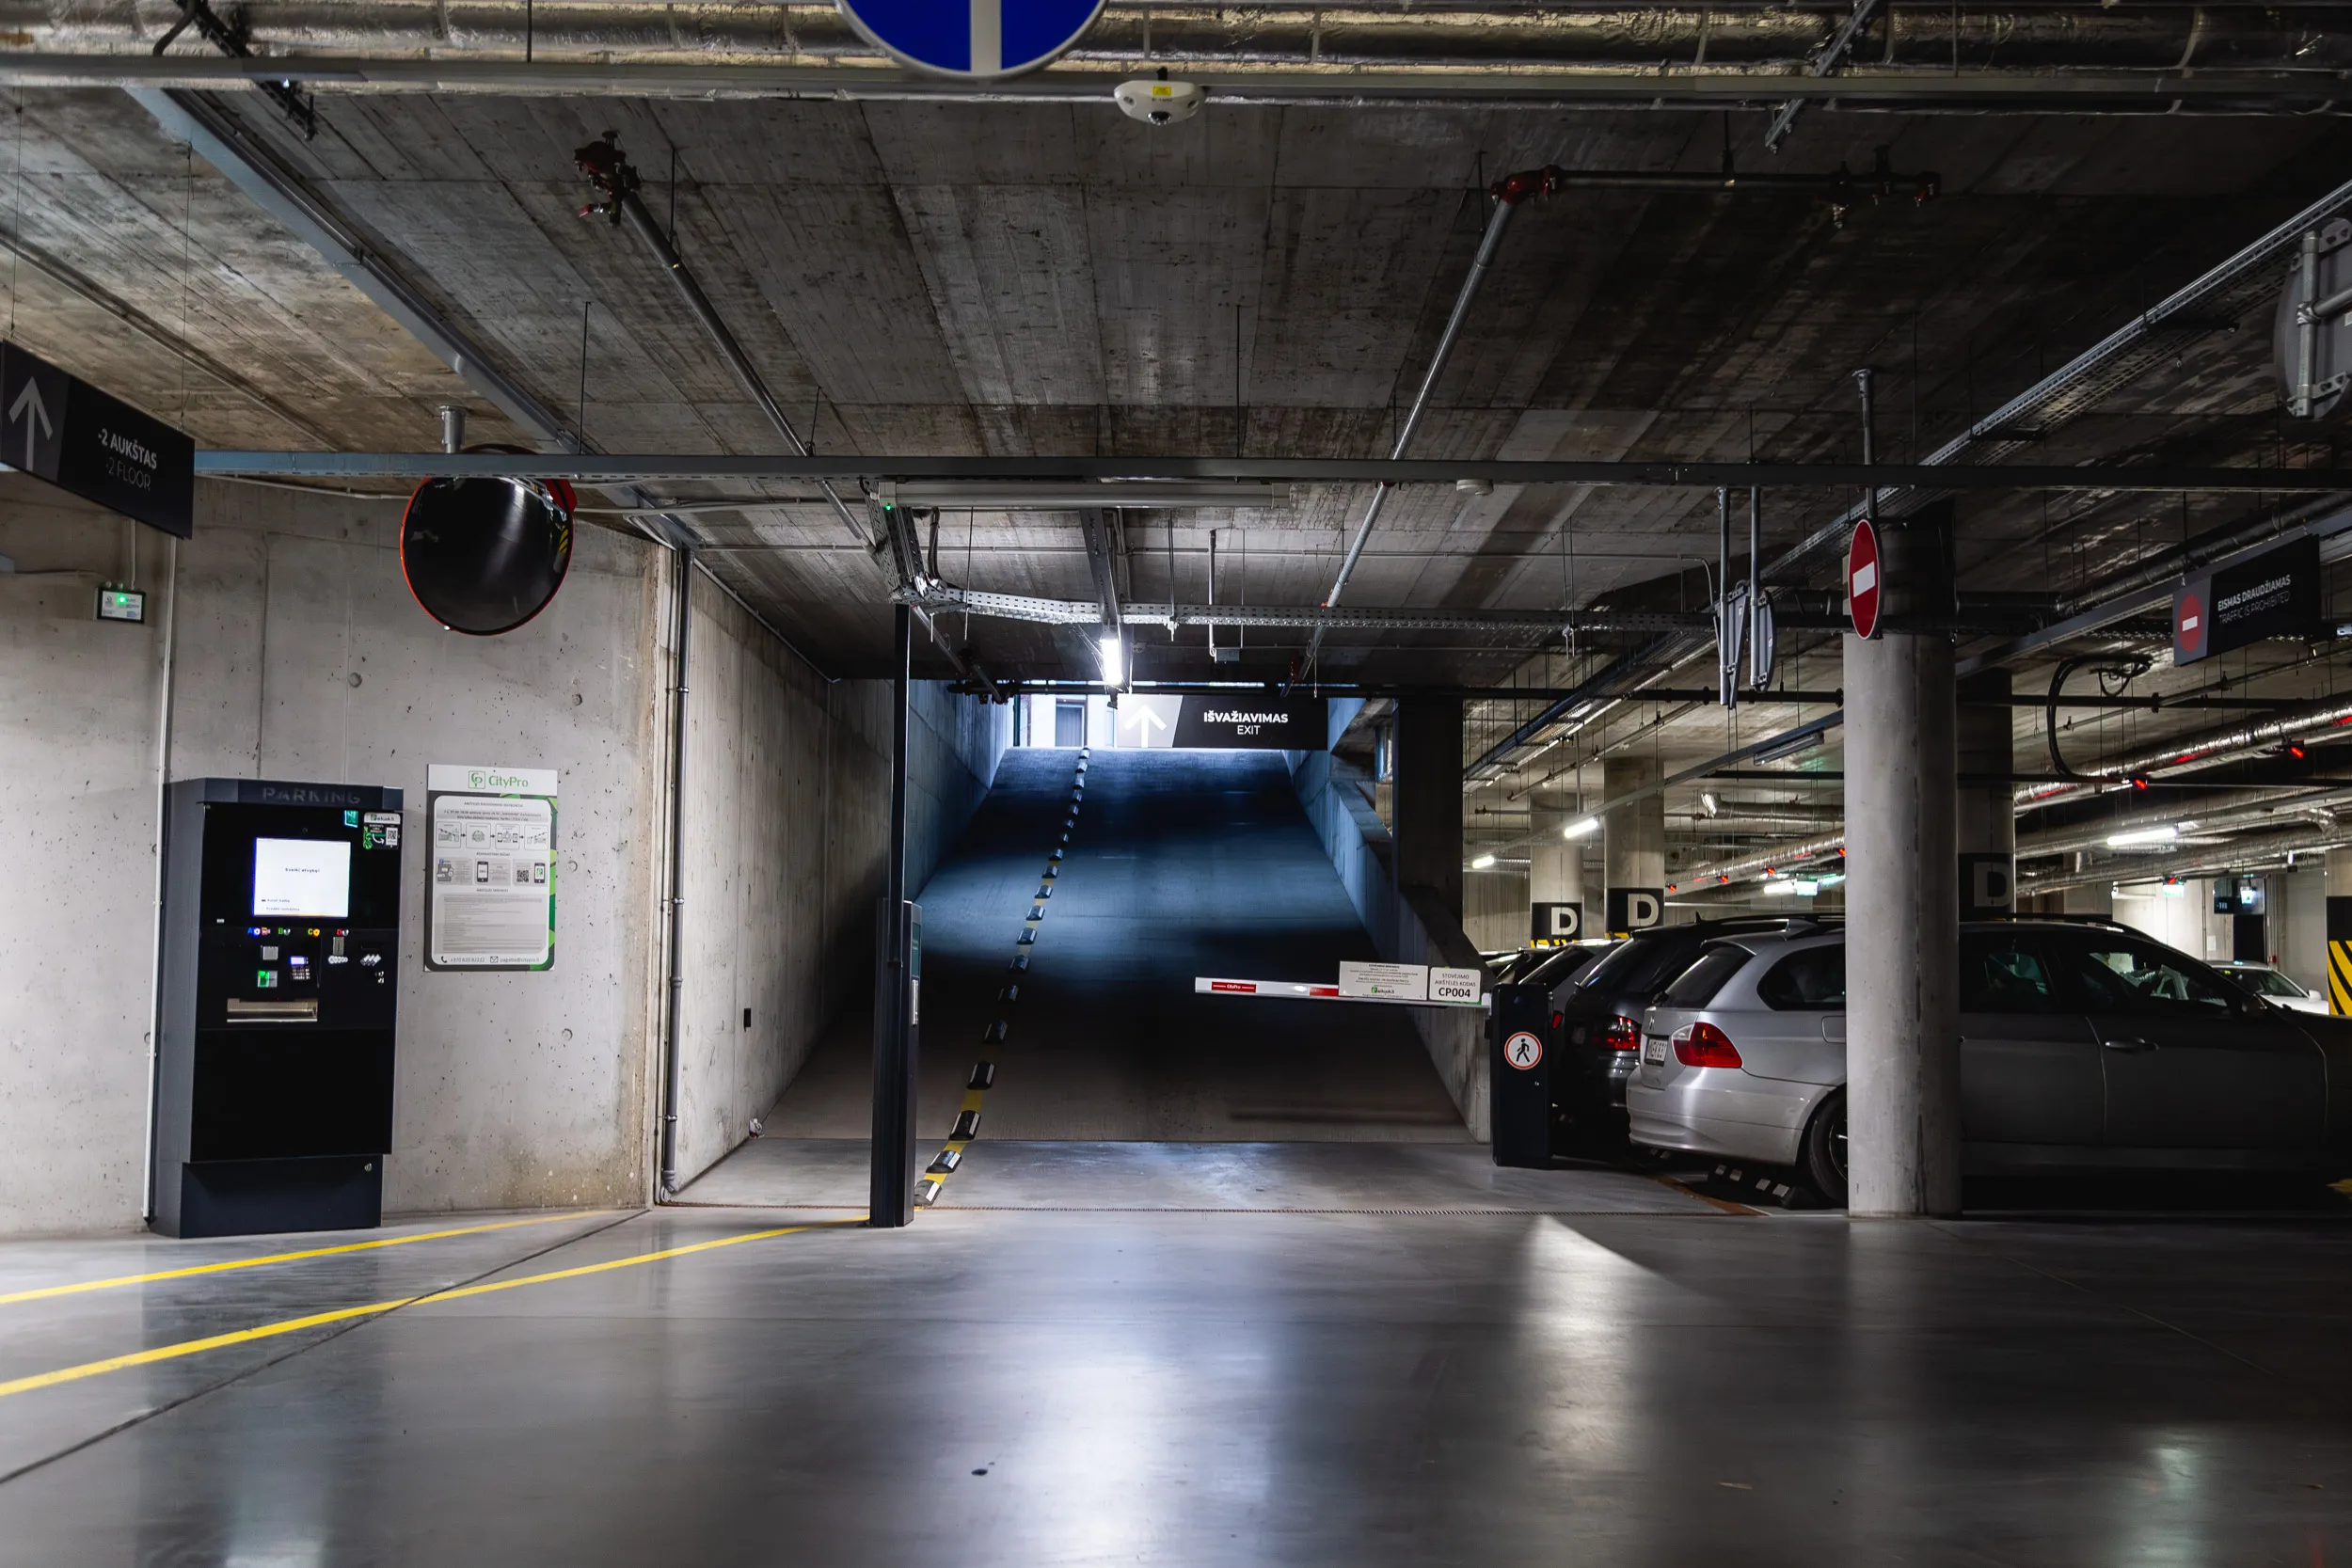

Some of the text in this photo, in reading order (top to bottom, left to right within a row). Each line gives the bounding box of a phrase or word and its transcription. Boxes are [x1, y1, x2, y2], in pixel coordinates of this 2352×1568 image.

[110, 433, 157, 469] AUKŠTAS
[117, 460, 151, 491] FLOOR
[2217, 574, 2291, 611] EISMAS DRAUDŽIAMAS
[2219, 591, 2289, 624] TRAFFIC IS PROHIBITED
[1203, 709, 1289, 723] IŠVAŽIAVIMAS
[1237, 725, 1261, 736] EXIT
[262, 786, 361, 805] PARKING
[488, 775, 529, 788] CityPro
[1974, 862, 2013, 908] D
[1551, 907, 1578, 935] D
[1628, 894, 1659, 927] D
[1438, 987, 1470, 998] CP004
